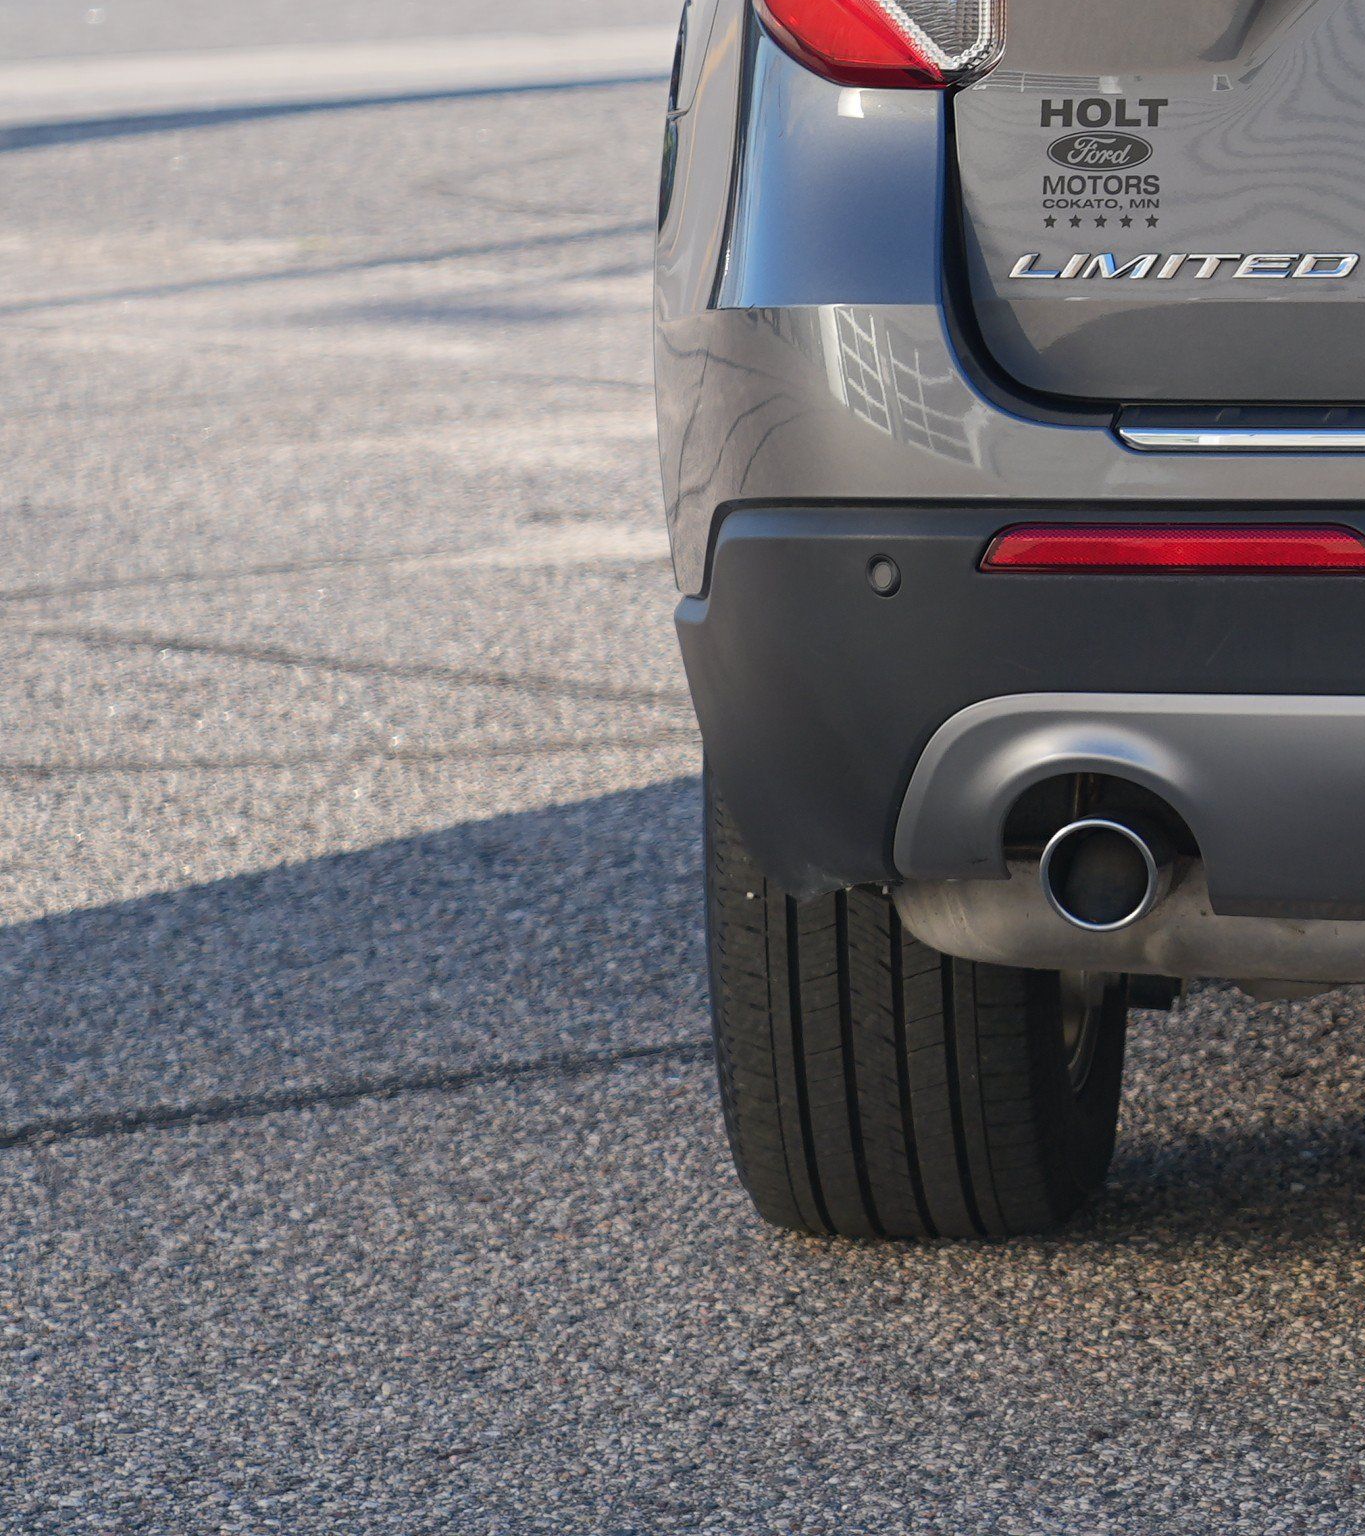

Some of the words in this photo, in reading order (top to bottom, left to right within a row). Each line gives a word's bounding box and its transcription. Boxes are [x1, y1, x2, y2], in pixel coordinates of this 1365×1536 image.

[1040, 98, 1169, 128] HOLT
[1067, 136, 1132, 165] Ford
[1042, 174, 1161, 195] MOTORS
[1042, 198, 1124, 212] COKATO,
[1129, 198, 1160, 209] MN
[1008, 252, 1361, 280] LIMITED
